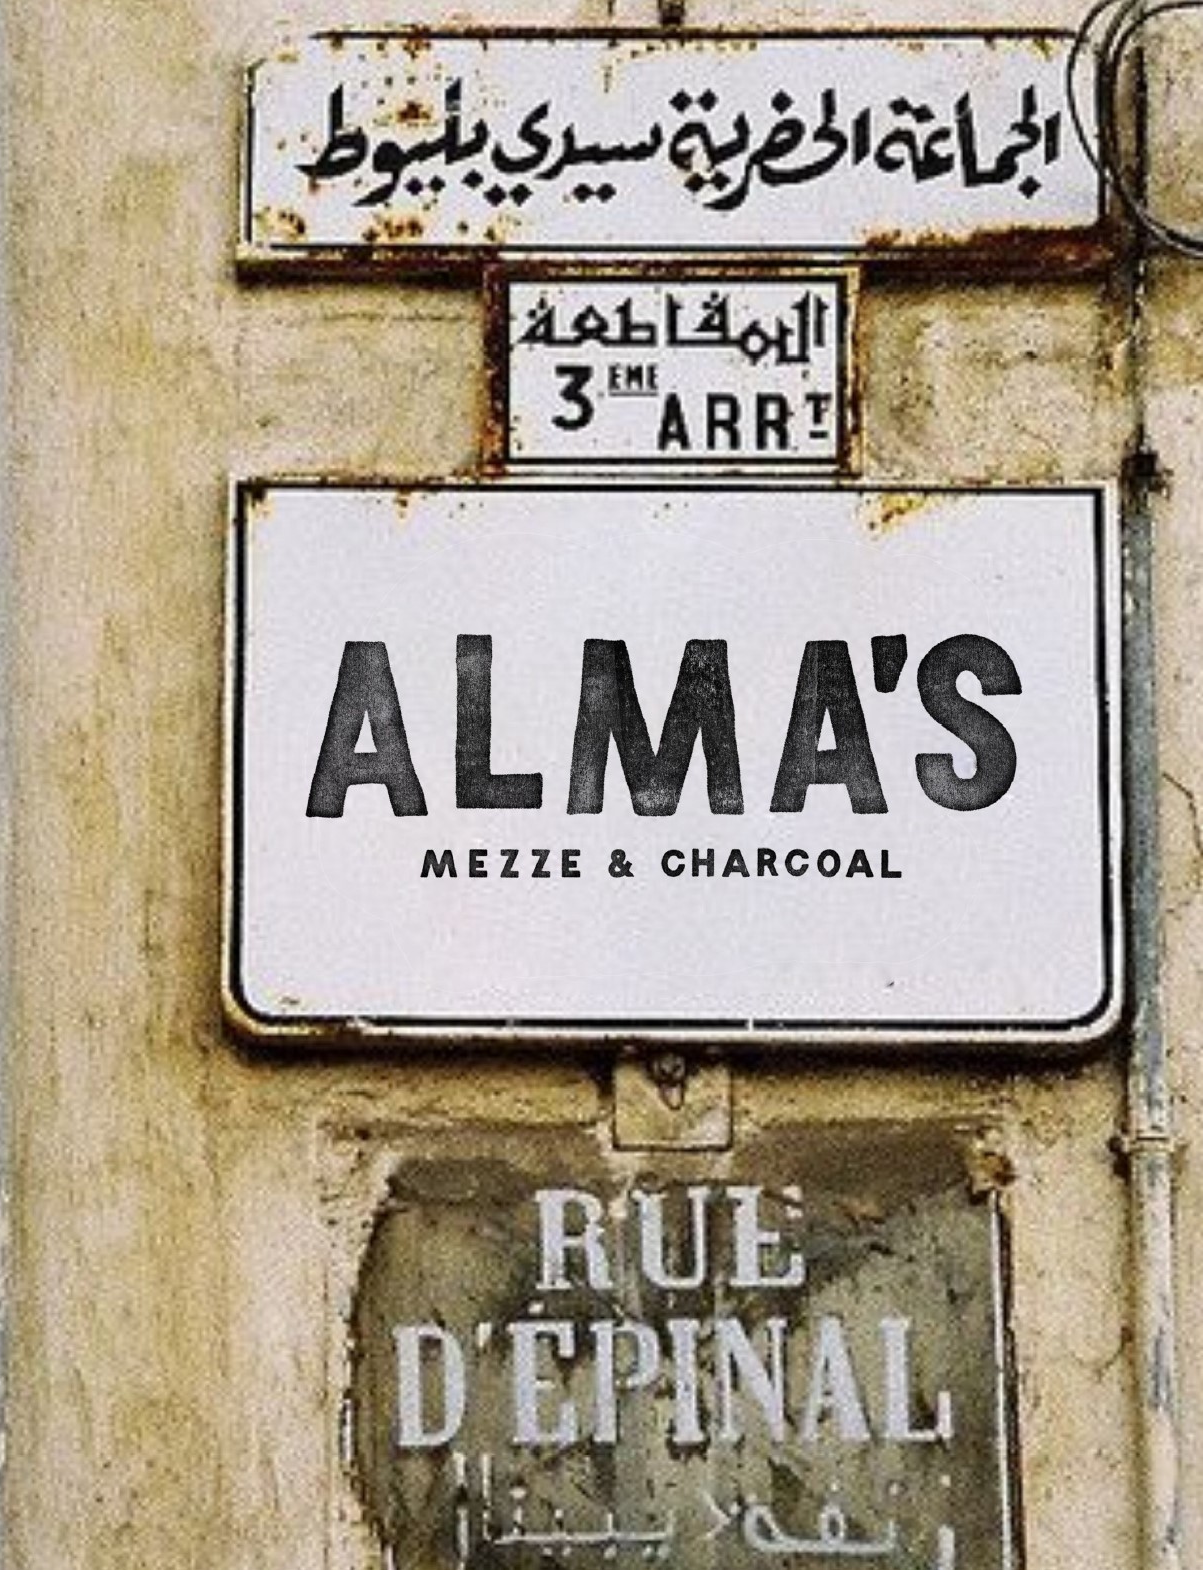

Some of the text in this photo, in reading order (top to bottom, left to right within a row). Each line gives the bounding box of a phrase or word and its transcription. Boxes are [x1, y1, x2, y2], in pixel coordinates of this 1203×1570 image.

[295, 77, 489, 207] بليوط
[483, 101, 663, 206] سيدي
[517, 290, 829, 366] المقاطعة
[306, 634, 1022, 818] ALMA'S
[420, 848, 902, 878] MEZZE & CHARCOAL
[535, 1185, 805, 1291] RUE
[392, 1303, 953, 1447] D'ÉPINAL
